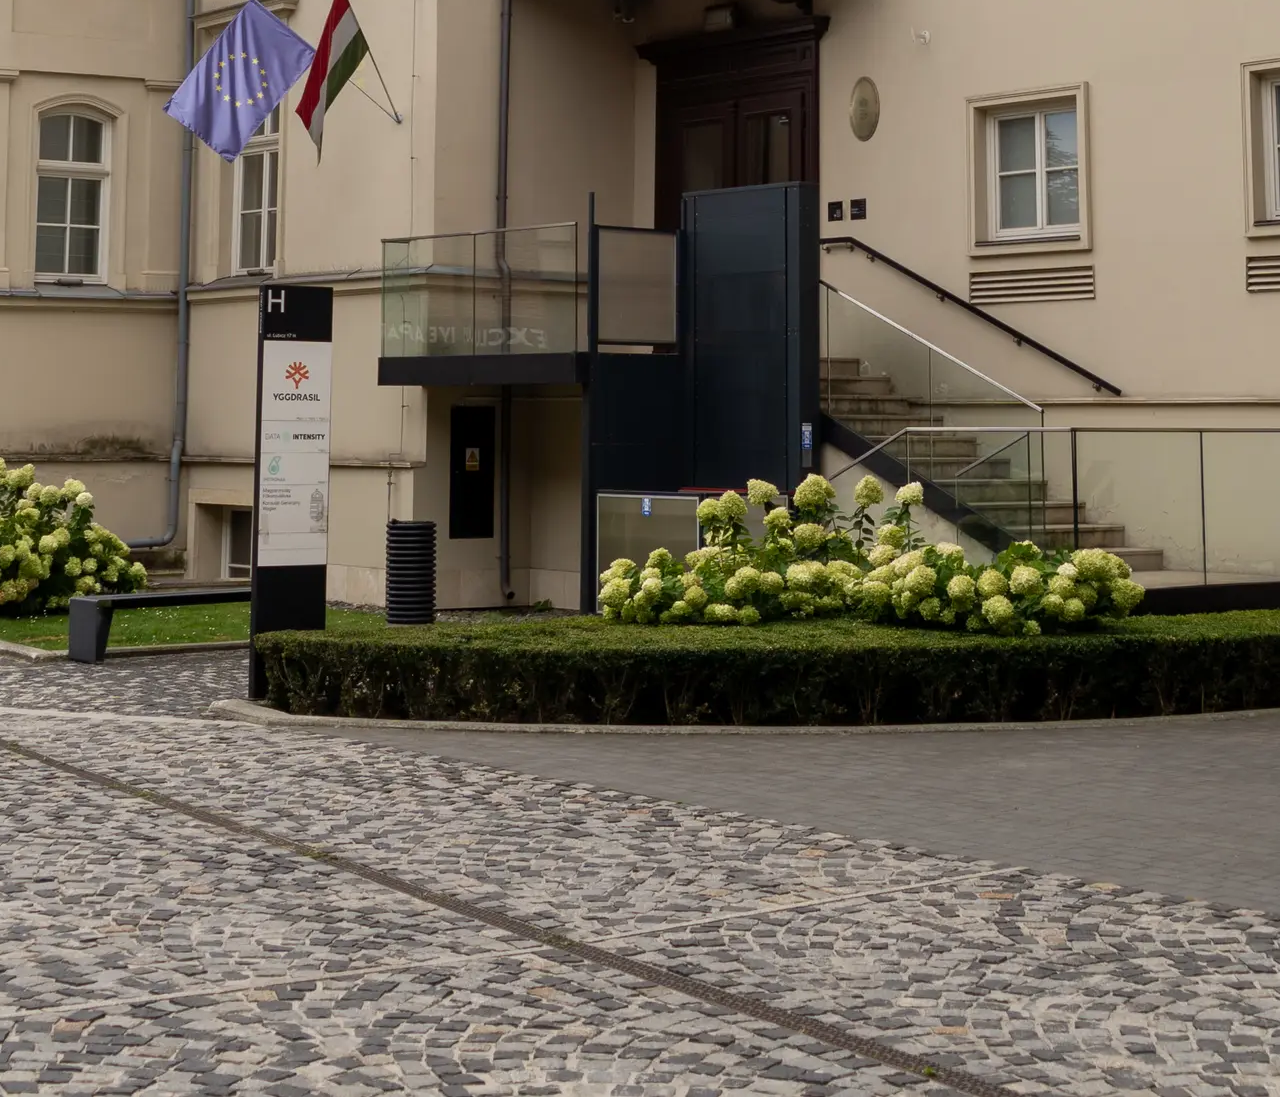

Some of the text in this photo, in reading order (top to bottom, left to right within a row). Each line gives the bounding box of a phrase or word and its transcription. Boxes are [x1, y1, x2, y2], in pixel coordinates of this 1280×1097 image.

[267, 289, 285, 313] H
[273, 393, 321, 402] YGGDRASIL
[292, 433, 326, 441] INTENSITY
